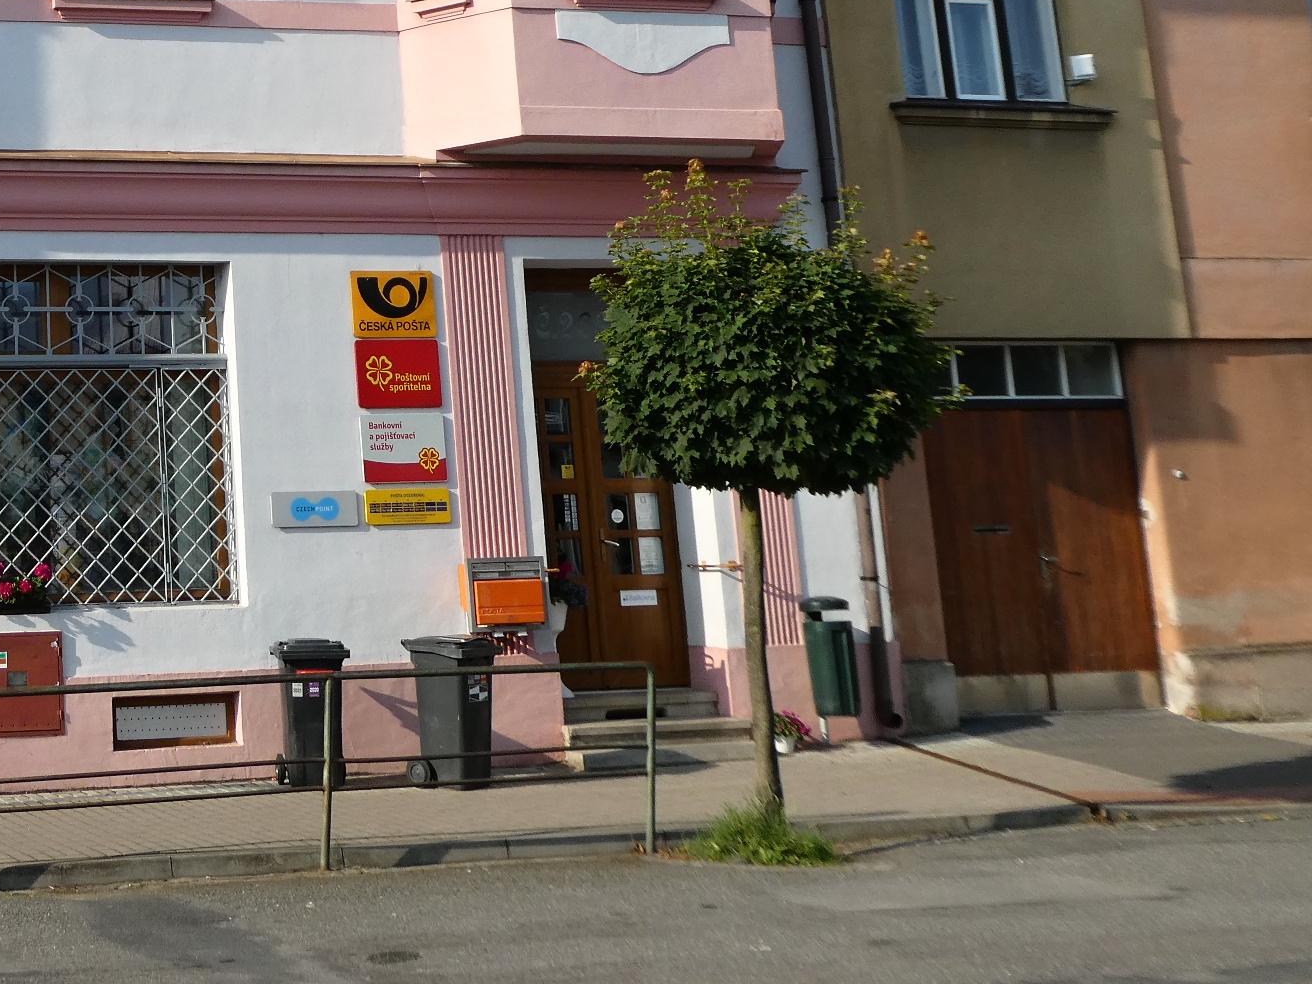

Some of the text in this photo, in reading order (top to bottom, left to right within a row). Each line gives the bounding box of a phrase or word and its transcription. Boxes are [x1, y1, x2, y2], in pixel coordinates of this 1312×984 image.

[359, 319, 431, 332] ČESKÁ POŠTA
[395, 372, 430, 382] Poštovní
[389, 382, 432, 393] spořitelna
[368, 420, 402, 430] Bankovní
[375, 431, 416, 442] pojišťovací
[370, 442, 394, 453] služby
